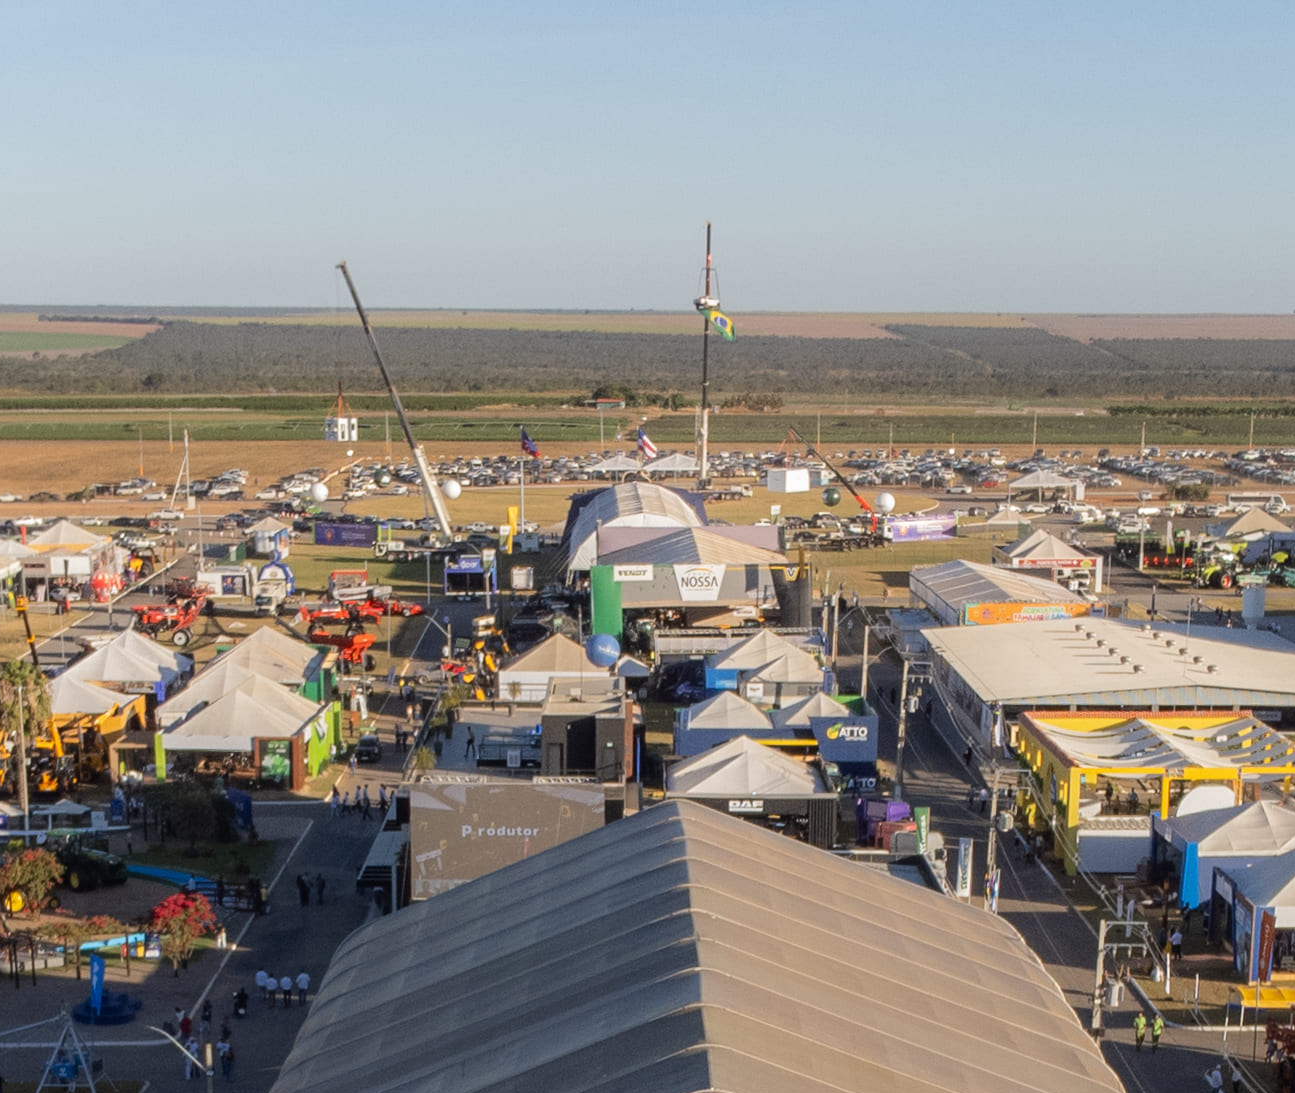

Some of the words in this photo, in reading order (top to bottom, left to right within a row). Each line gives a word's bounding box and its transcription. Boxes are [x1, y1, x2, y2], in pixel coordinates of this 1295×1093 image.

[680, 576, 719, 589] NOSSA
[838, 727, 868, 737] ATTO
[729, 800, 764, 809] DAF
